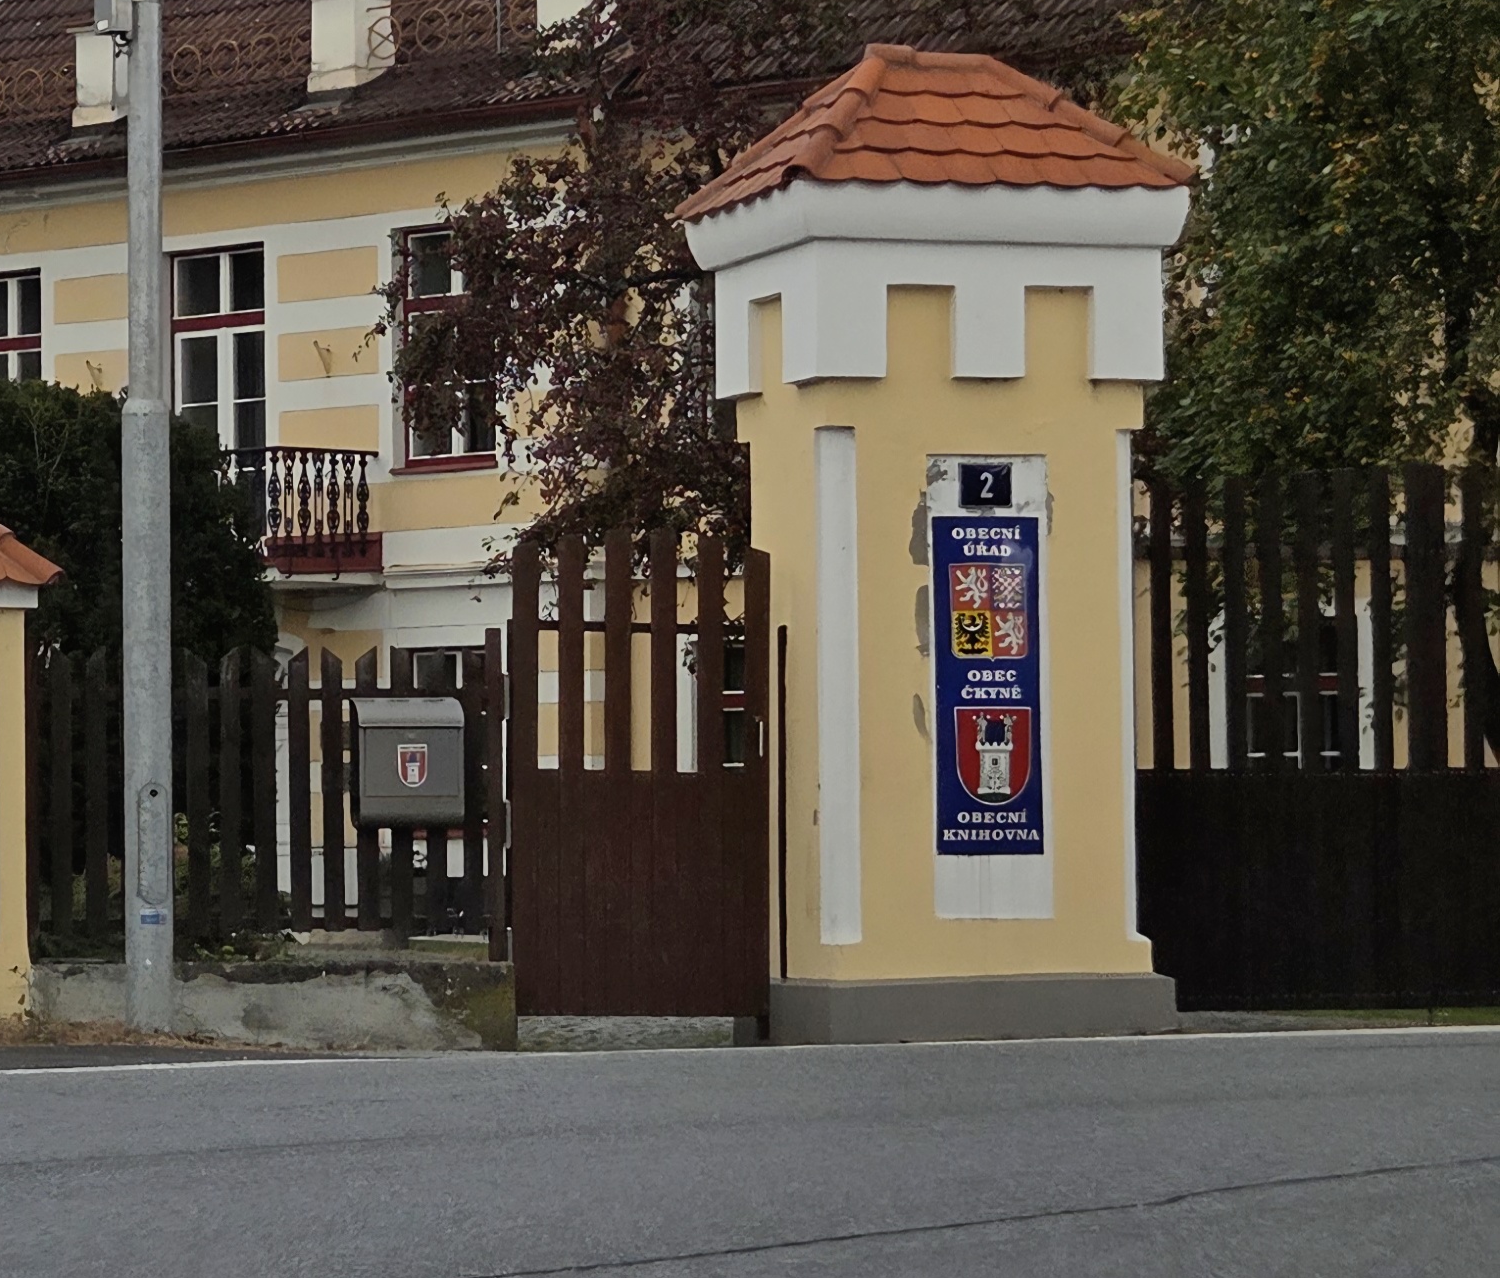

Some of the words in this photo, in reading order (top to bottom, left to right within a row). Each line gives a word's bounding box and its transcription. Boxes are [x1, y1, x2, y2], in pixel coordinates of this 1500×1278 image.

[980, 471, 995, 499] 2
[951, 524, 1022, 540] OBECNÍ
[967, 669, 1018, 682] OBEC
[956, 807, 1027, 824] OBECNÍ
[942, 828, 1040, 841] KNIHOVNA
